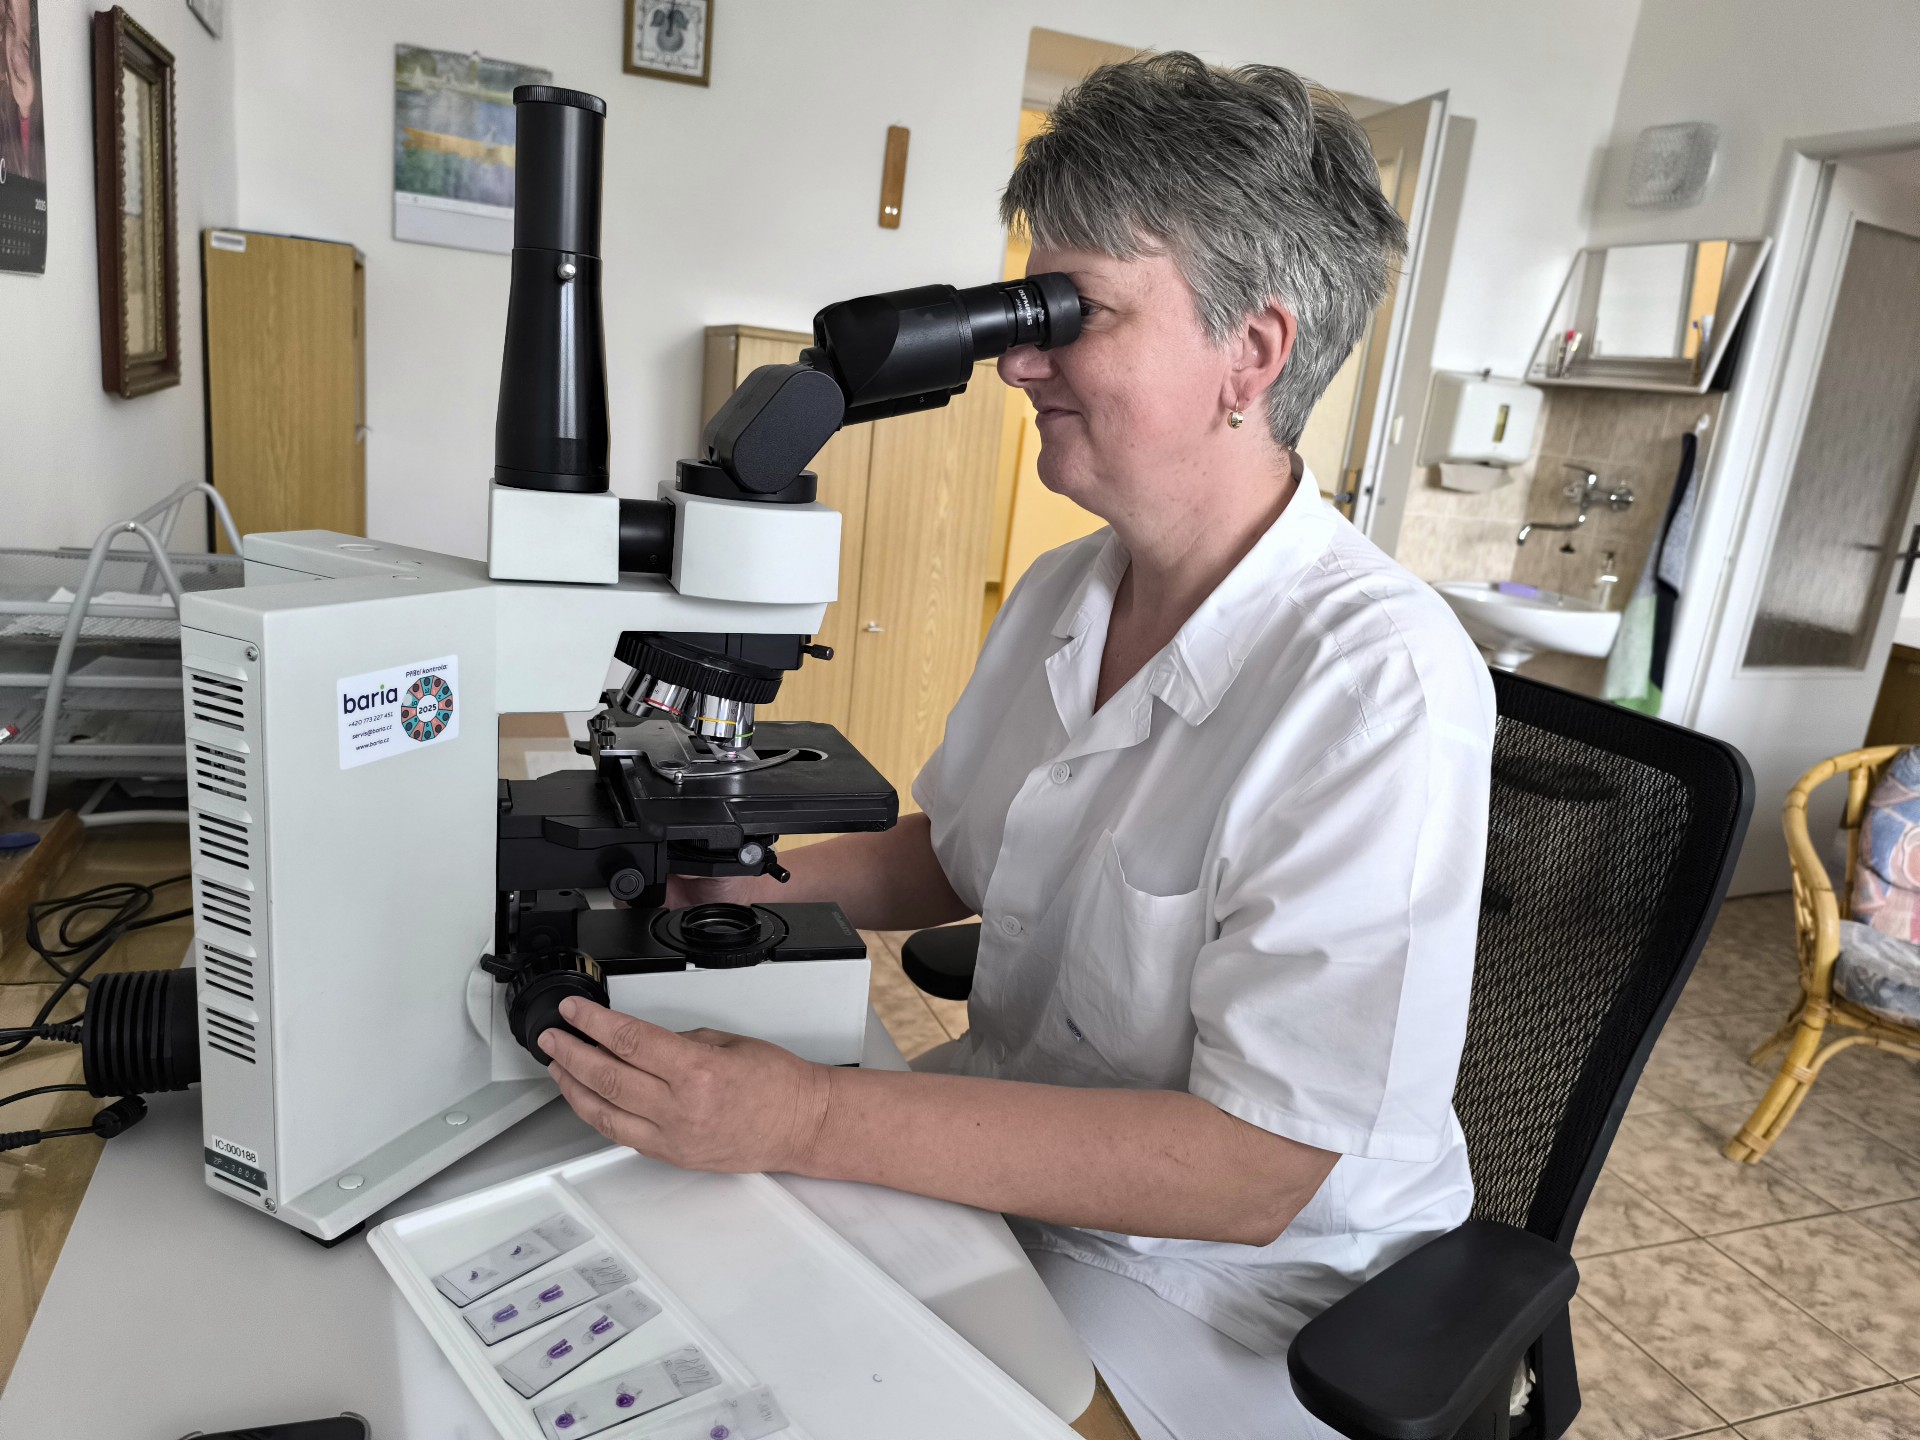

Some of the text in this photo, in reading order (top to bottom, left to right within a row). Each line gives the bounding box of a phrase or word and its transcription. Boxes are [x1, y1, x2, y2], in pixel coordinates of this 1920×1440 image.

[1018, 289, 1033, 325] OLYMPUS
[343, 684, 398, 714] baria
[418, 703, 437, 715] 2025
[352, 725, 392, 739] servis@baria.cz
[355, 738, 390, 750] www.baria.cz
[215, 1139, 257, 1163] IC:000188
